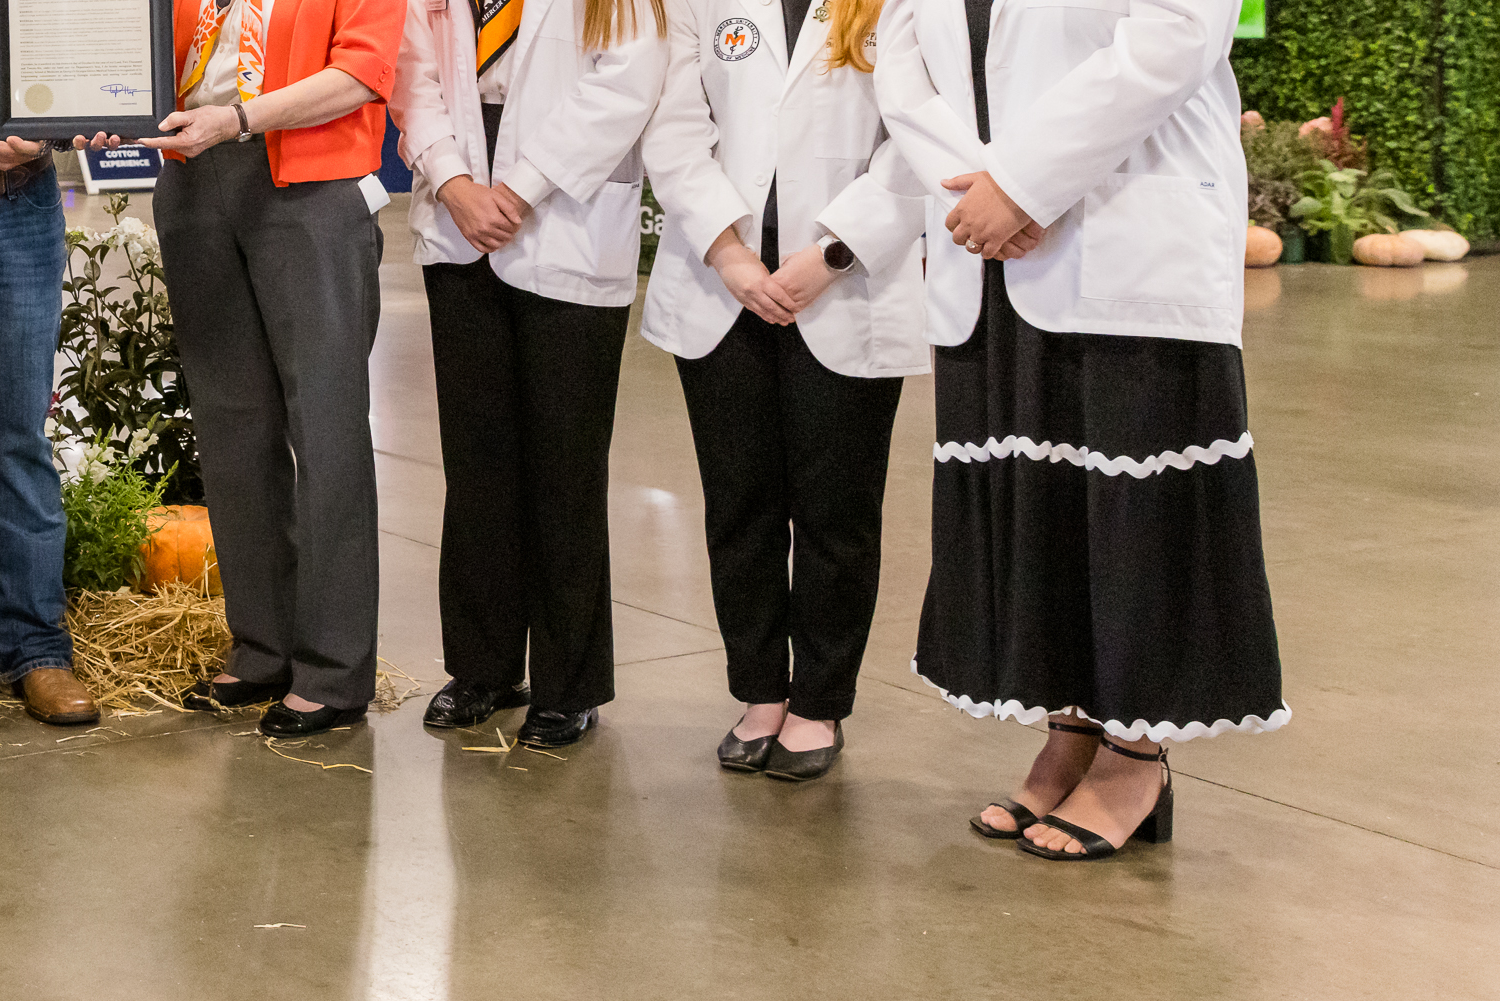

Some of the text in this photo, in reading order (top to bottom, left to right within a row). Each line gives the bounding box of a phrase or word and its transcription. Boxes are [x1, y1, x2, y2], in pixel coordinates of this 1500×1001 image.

[481, 0, 504, 23] MERCER
[105, 150, 140, 158] COTTON
[99, 159, 151, 168] EXPERIENCE
[640, 205, 665, 236] Ga
